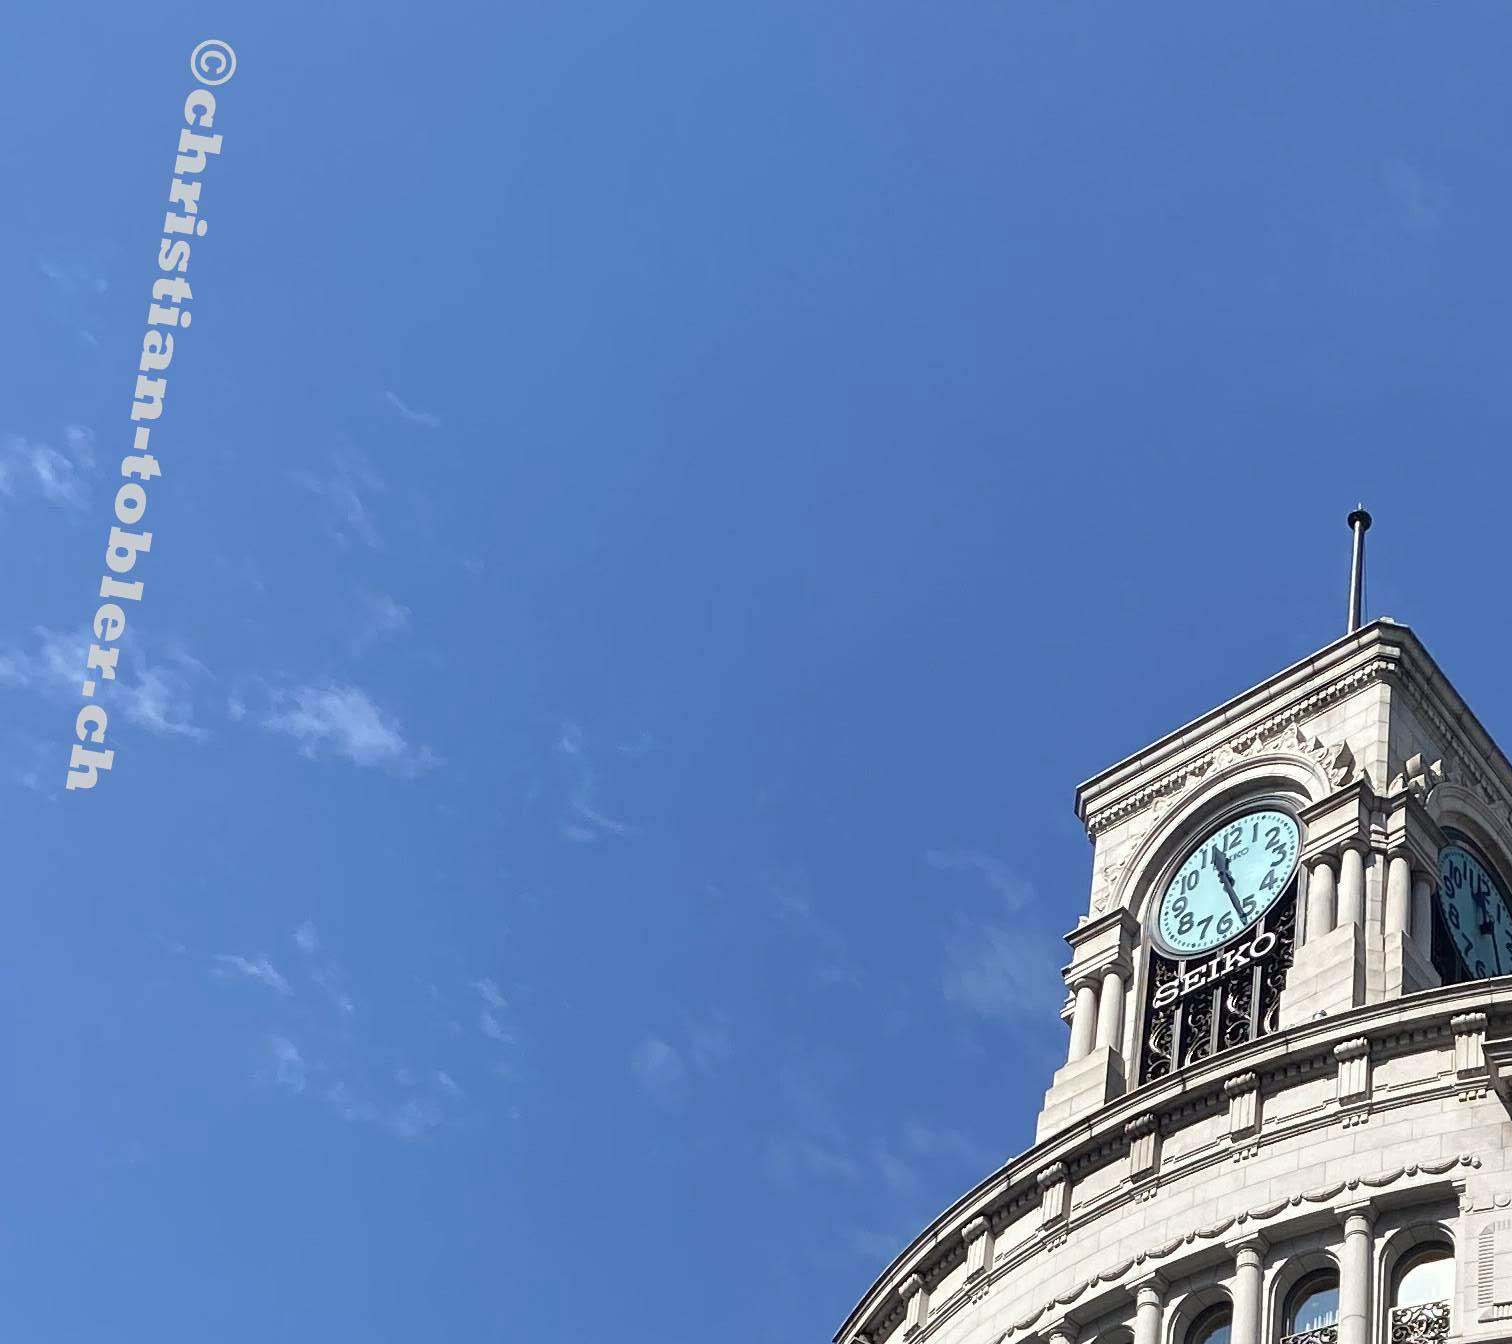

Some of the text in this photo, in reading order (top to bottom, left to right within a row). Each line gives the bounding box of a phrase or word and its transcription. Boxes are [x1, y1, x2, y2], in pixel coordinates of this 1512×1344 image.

[1222, 826, 1243, 852] 12
[1252, 822, 1259, 843] 1
[1265, 826, 1281, 850] 2
[1270, 842, 1288, 867] 3
[1180, 869, 1200, 896] 10
[1259, 868, 1279, 891] 4
[1171, 895, 1189, 919] 9
[1242, 893, 1257, 918] 5
[1177, 911, 1194, 936] 8
[1196, 914, 1214, 940] 7
[1216, 910, 1233, 935] 6
[1152, 932, 1276, 1009] SEIKO
